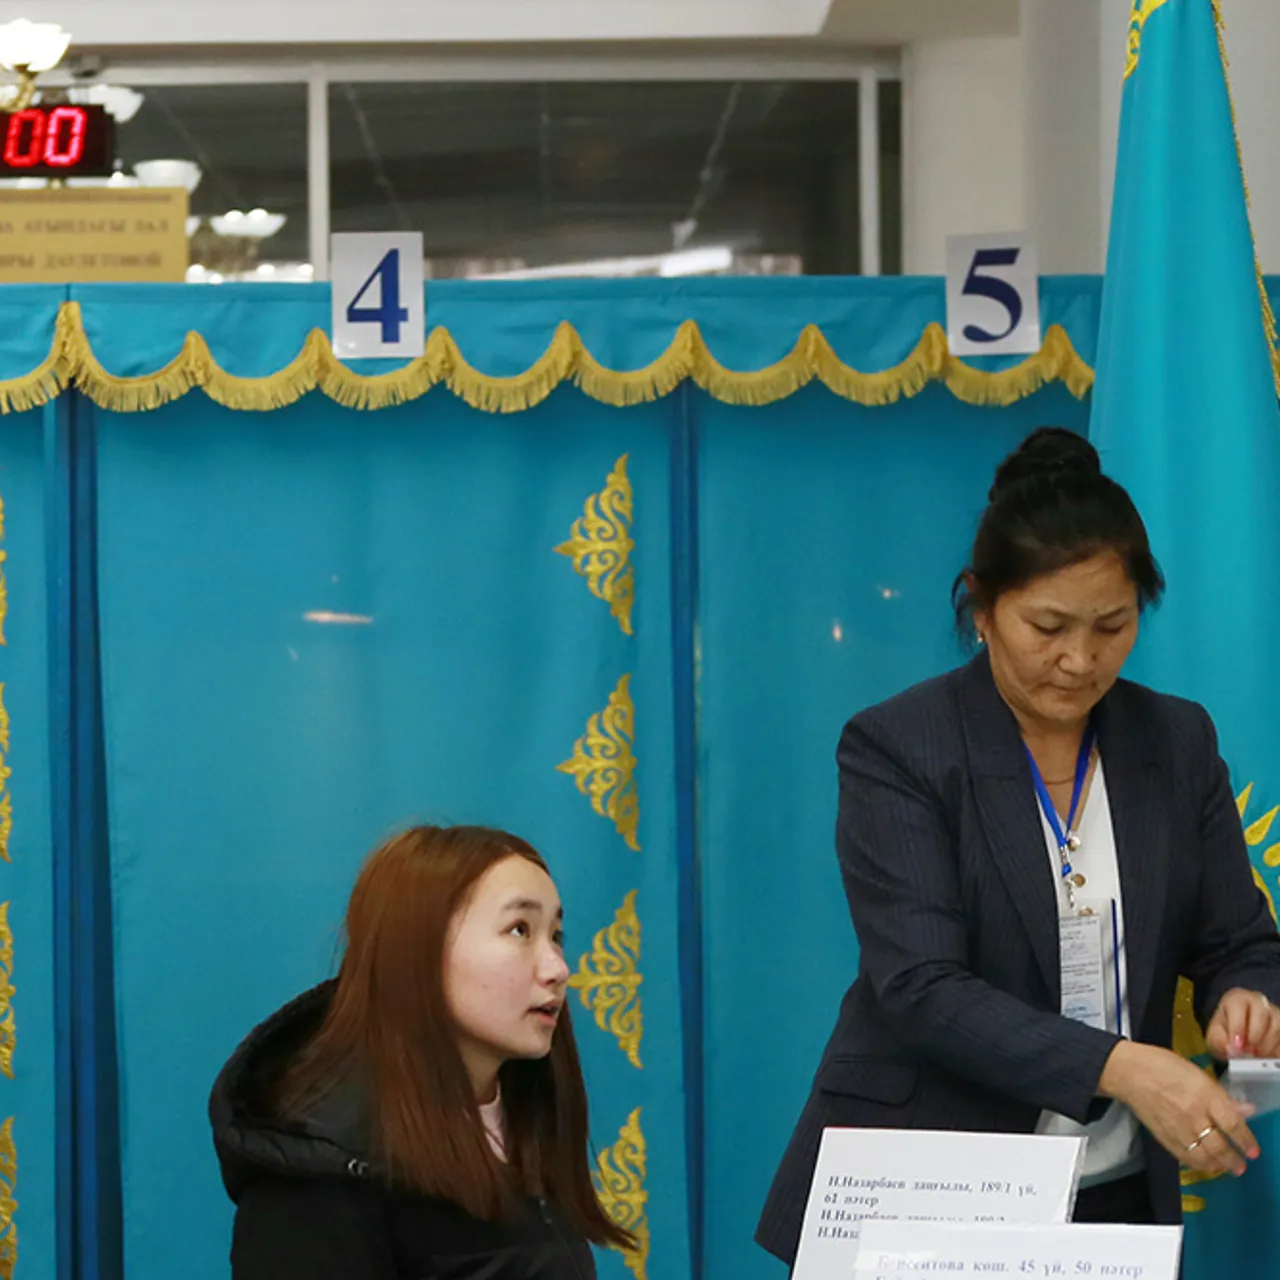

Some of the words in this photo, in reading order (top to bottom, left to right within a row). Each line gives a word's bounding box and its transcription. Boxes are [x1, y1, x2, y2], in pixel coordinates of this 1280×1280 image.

[346, 248, 409, 344] 4
[961, 247, 1023, 344] 5
[824, 1193, 838, 1204] 61
[1018, 1259, 1036, 1273] 45
[1074, 1260, 1093, 1274] 50
